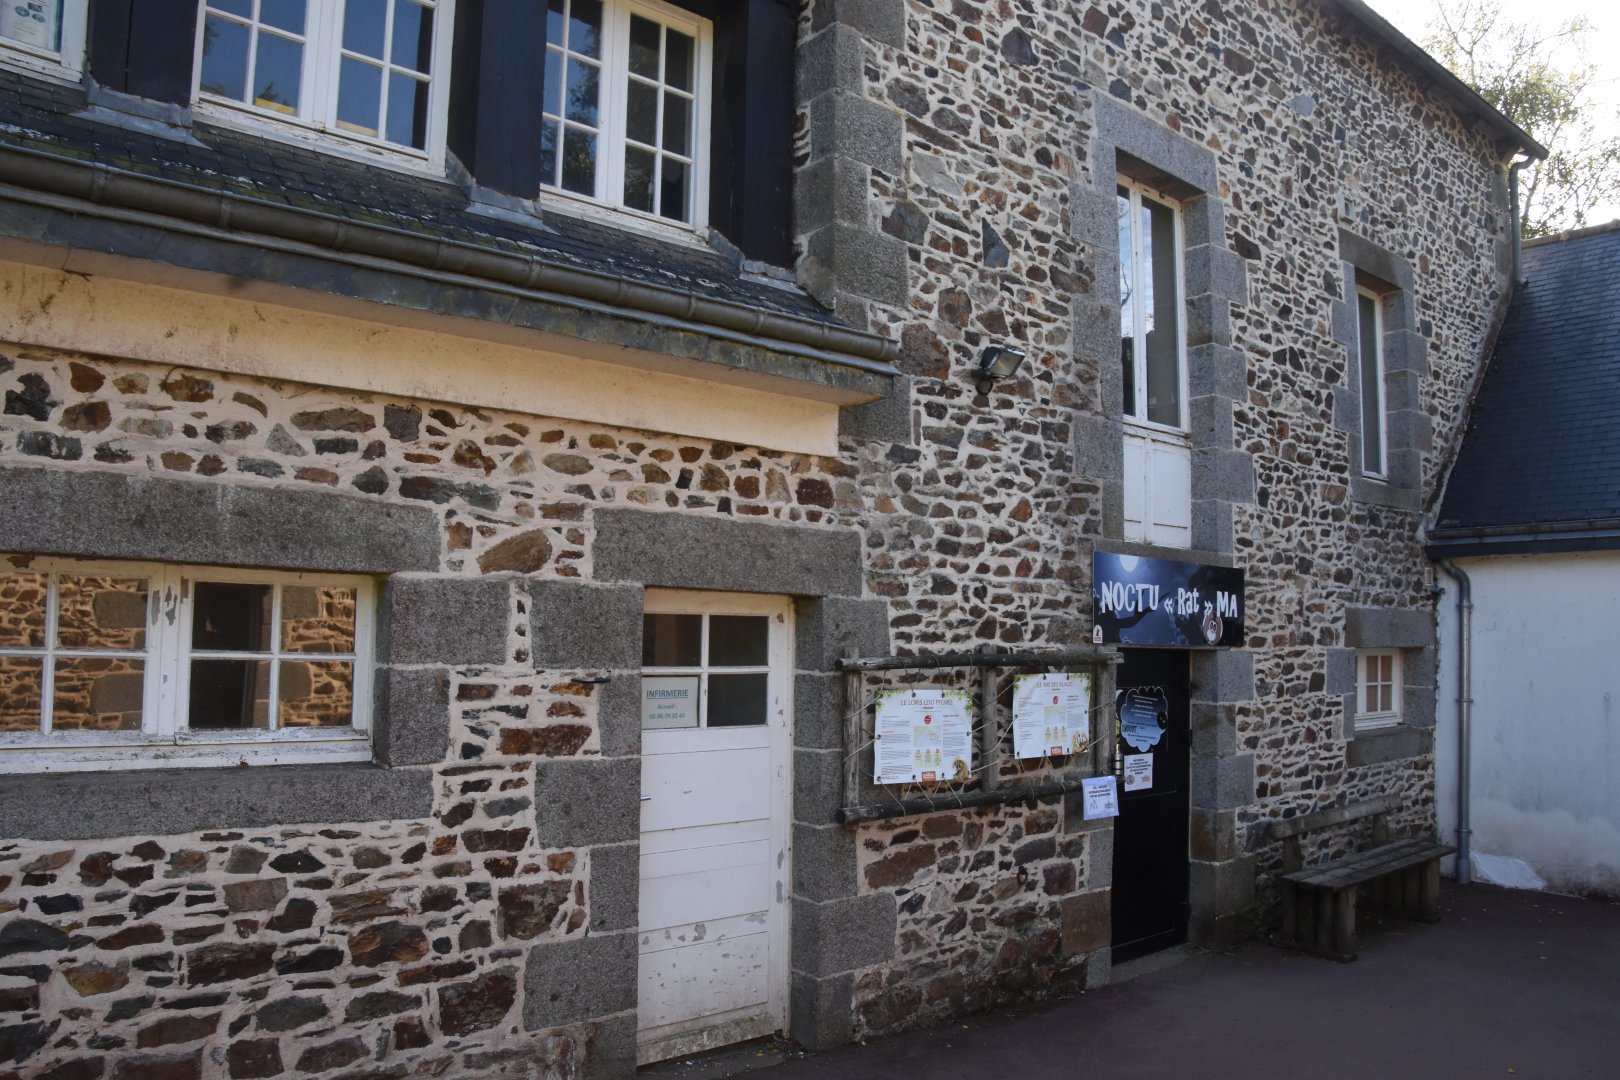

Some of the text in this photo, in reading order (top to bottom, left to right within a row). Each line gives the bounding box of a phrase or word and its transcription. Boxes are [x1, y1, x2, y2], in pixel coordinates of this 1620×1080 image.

[1101, 580, 1160, 614] NOCTU
[1177, 587, 1200, 615] Rat
[1216, 591, 1238, 618] MA
[646, 689, 689, 698] INFIRMERIE
